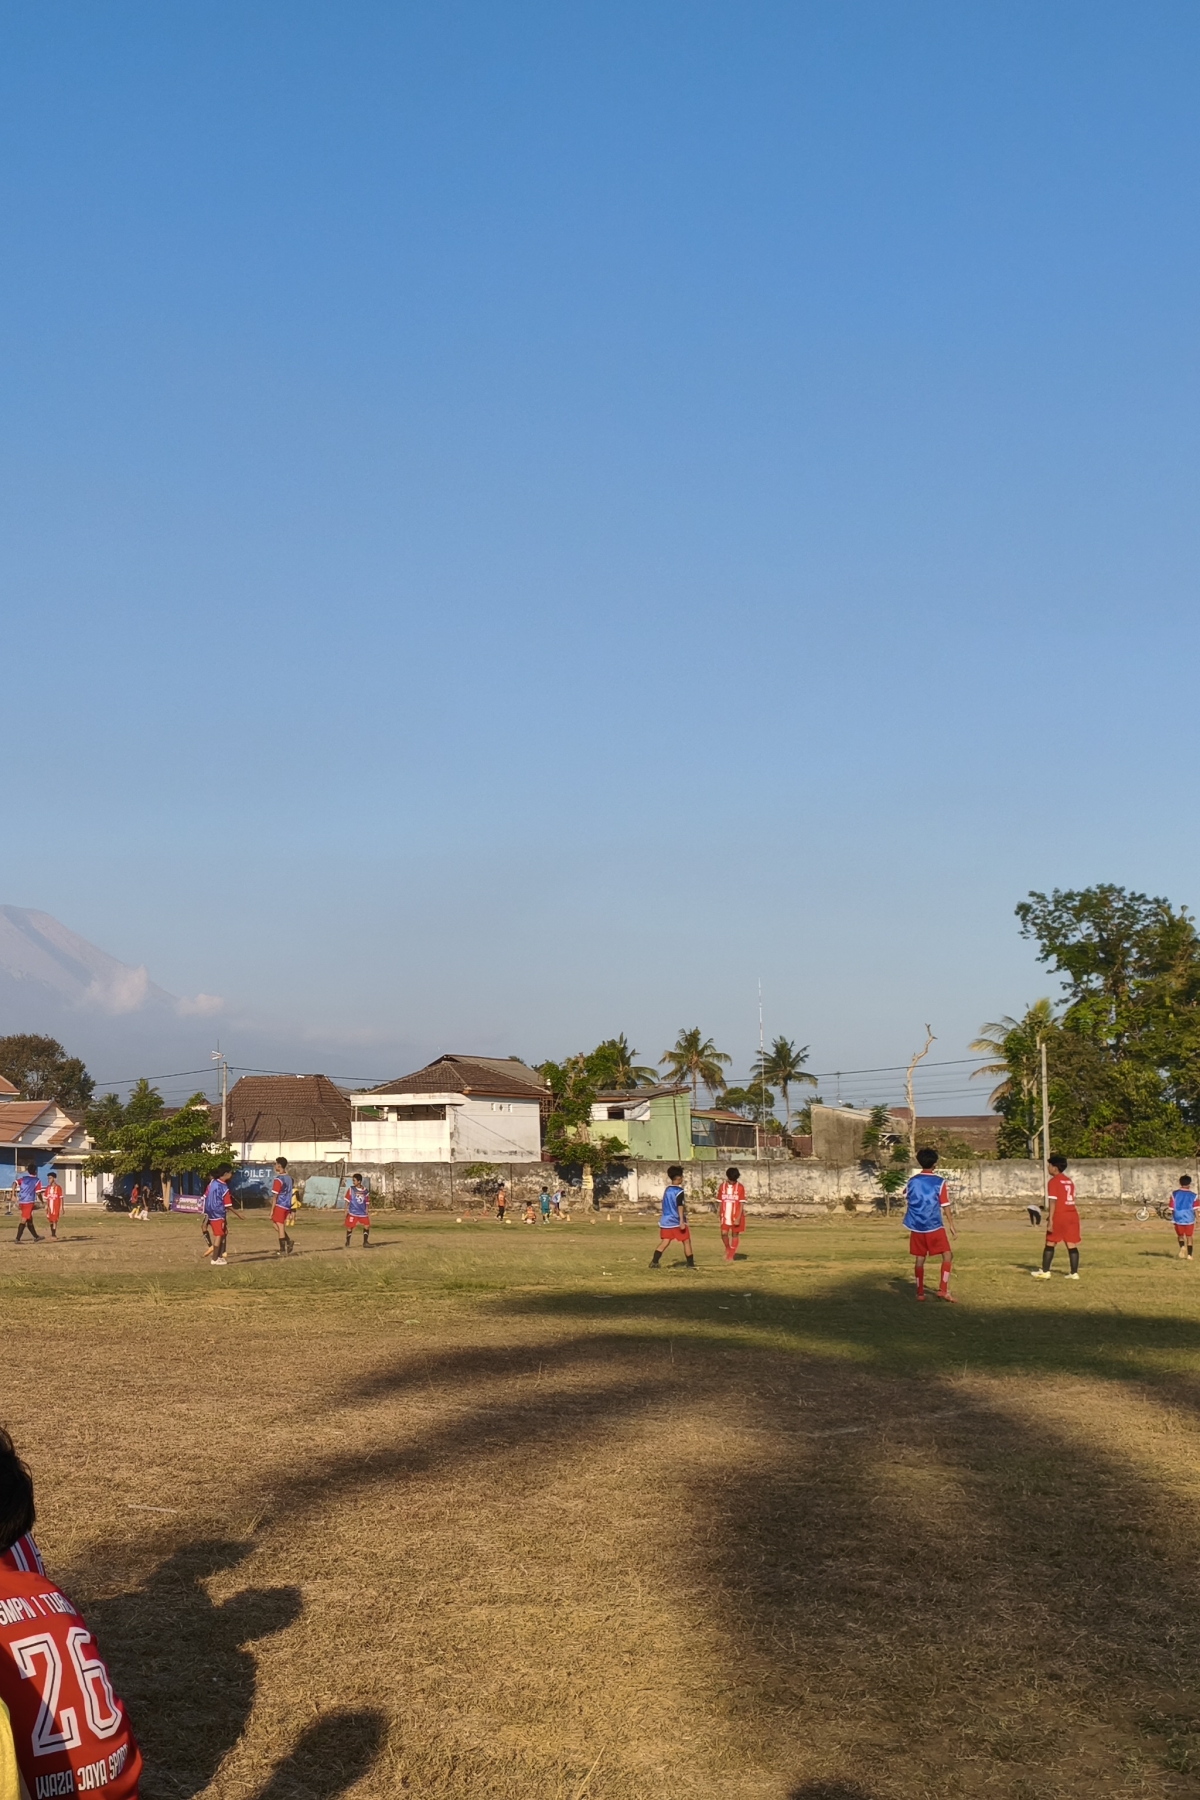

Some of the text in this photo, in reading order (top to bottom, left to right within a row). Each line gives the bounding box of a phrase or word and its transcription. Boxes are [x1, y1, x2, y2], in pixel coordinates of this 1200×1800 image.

[239, 1169, 272, 1178] TOILET
[30, 1596, 47, 1616] 1
[9, 1626, 123, 1757] 26
[35, 1769, 74, 1800] WAZA
[77, 1759, 108, 1791] JAYA
